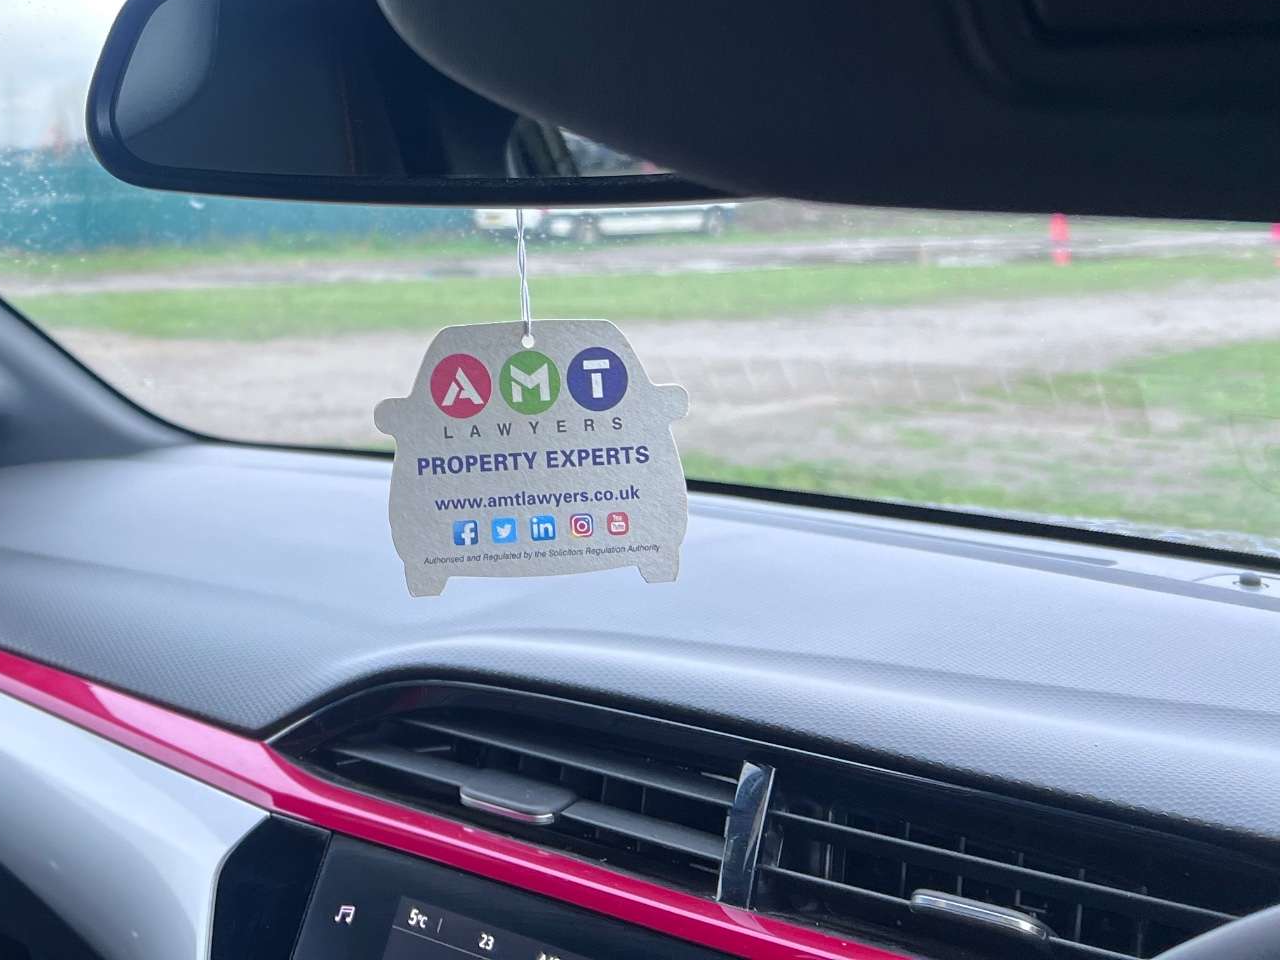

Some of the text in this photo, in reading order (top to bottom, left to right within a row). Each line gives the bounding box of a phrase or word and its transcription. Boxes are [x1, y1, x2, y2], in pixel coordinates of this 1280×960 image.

[417, 445, 650, 476] PROPERTY EXPERTS
[435, 485, 640, 512] www.amtlawyers.co.uk
[423, 543, 661, 565] Authorised and Regulated by the Solicitors Regulation Authority
[479, 933, 494, 951] 23
